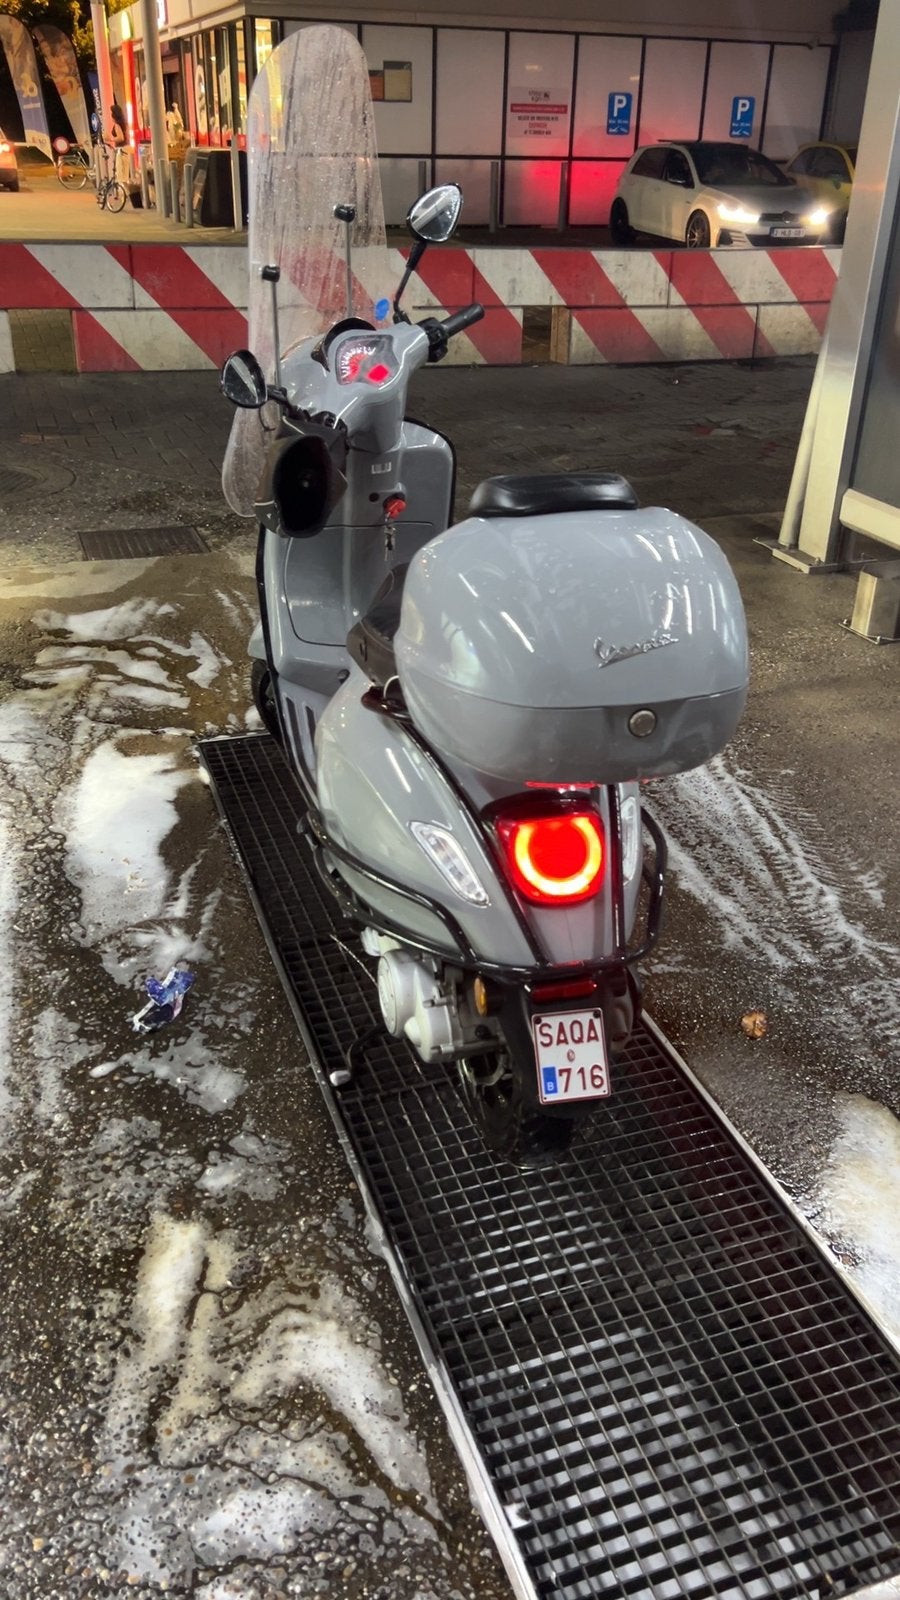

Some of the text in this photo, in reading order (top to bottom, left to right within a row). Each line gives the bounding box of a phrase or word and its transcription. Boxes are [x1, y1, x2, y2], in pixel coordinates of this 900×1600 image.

[613, 95, 627, 117] P
[736, 99, 750, 121] P
[593, 633, 680, 668] Vespa
[539, 1019, 599, 1047] SAQA
[547, 1064, 605, 1093] B 716
